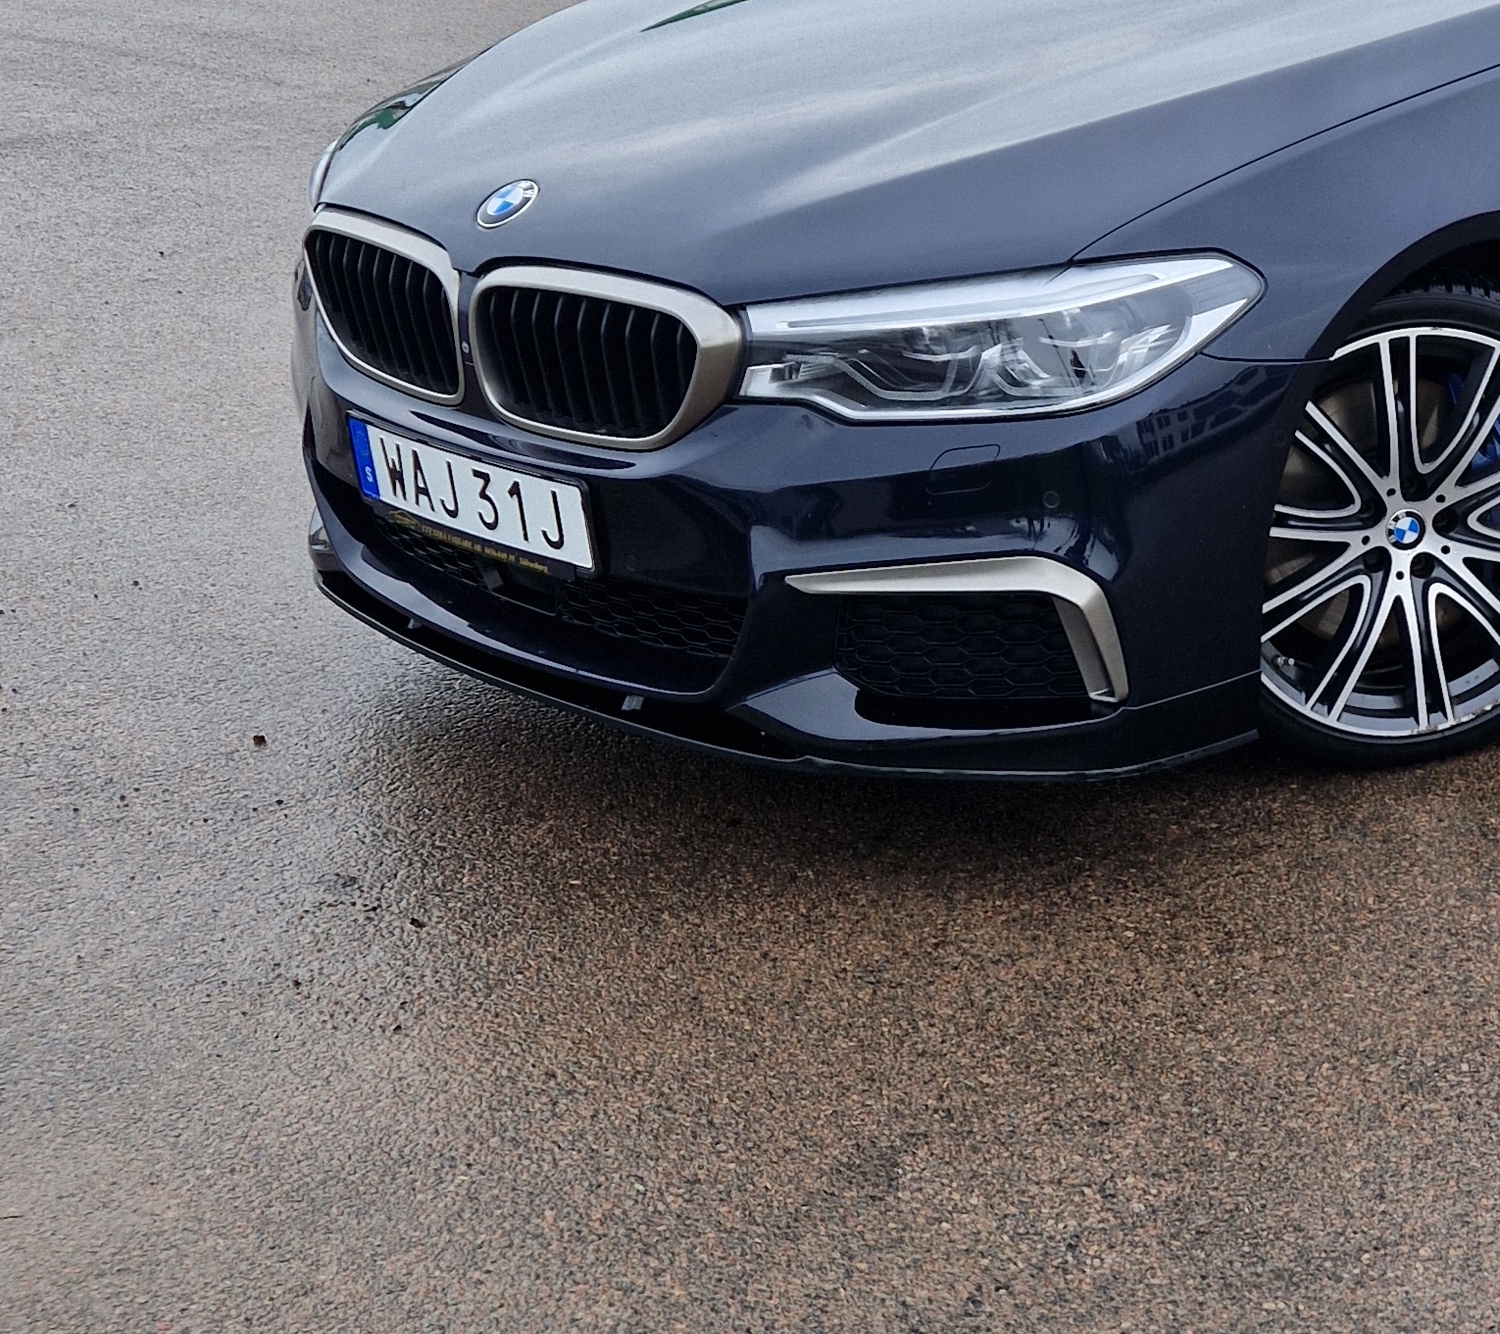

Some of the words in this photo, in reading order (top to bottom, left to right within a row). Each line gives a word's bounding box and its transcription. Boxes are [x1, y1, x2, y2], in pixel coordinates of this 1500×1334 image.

[364, 465, 374, 482] S
[380, 437, 459, 519] WAJ
[471, 468, 565, 550] 31J
